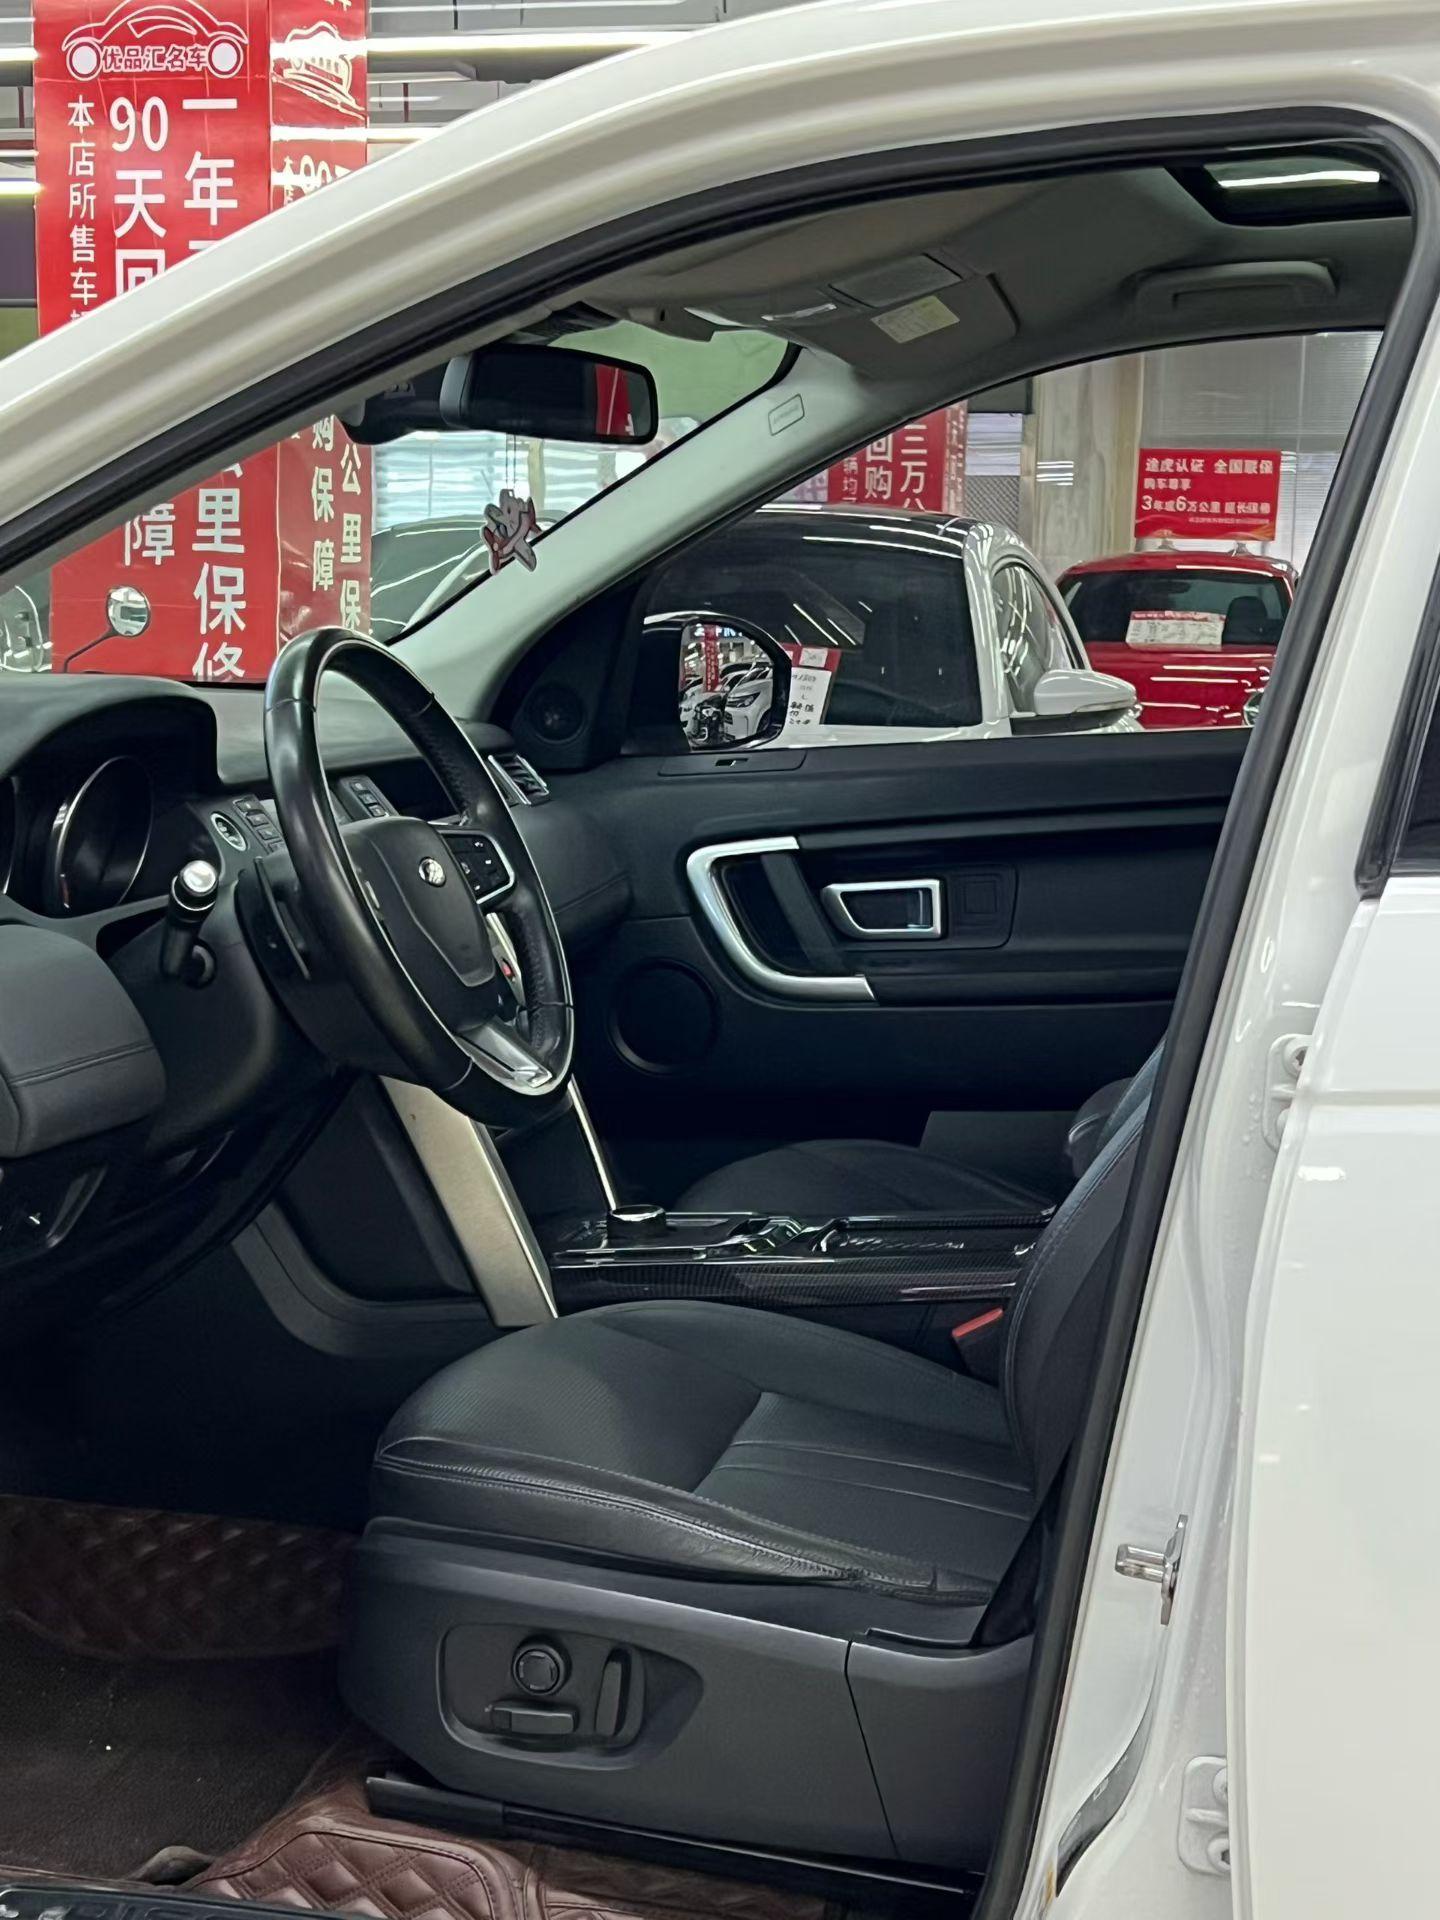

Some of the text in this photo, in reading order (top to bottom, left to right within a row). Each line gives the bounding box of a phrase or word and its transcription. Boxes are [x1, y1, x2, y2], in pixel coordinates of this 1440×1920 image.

[102, 44, 208, 72] 优品汇名车
[67, 94, 98, 322] 本店所售车
[192, 463, 247, 682] 里保修
